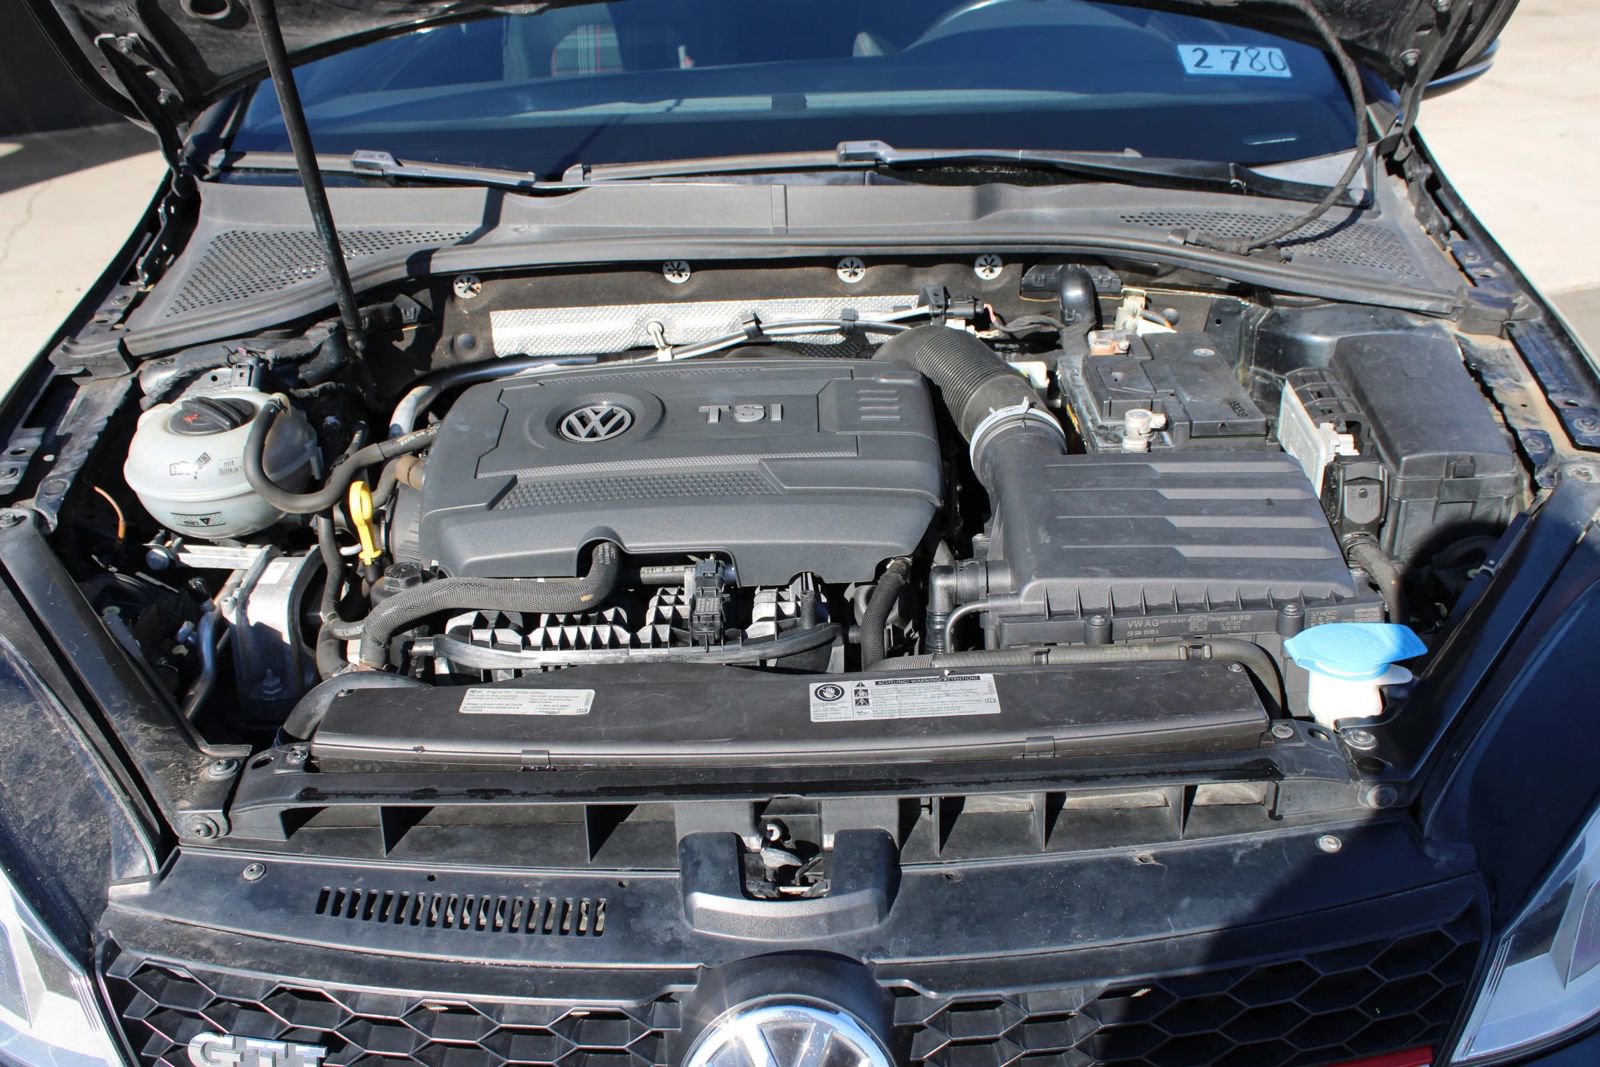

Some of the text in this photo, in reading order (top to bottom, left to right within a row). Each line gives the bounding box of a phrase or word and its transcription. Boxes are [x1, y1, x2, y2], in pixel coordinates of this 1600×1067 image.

[1191, 46, 1287, 72] 2780
[559, 404, 634, 442] VW
[698, 403, 783, 424] TSI
